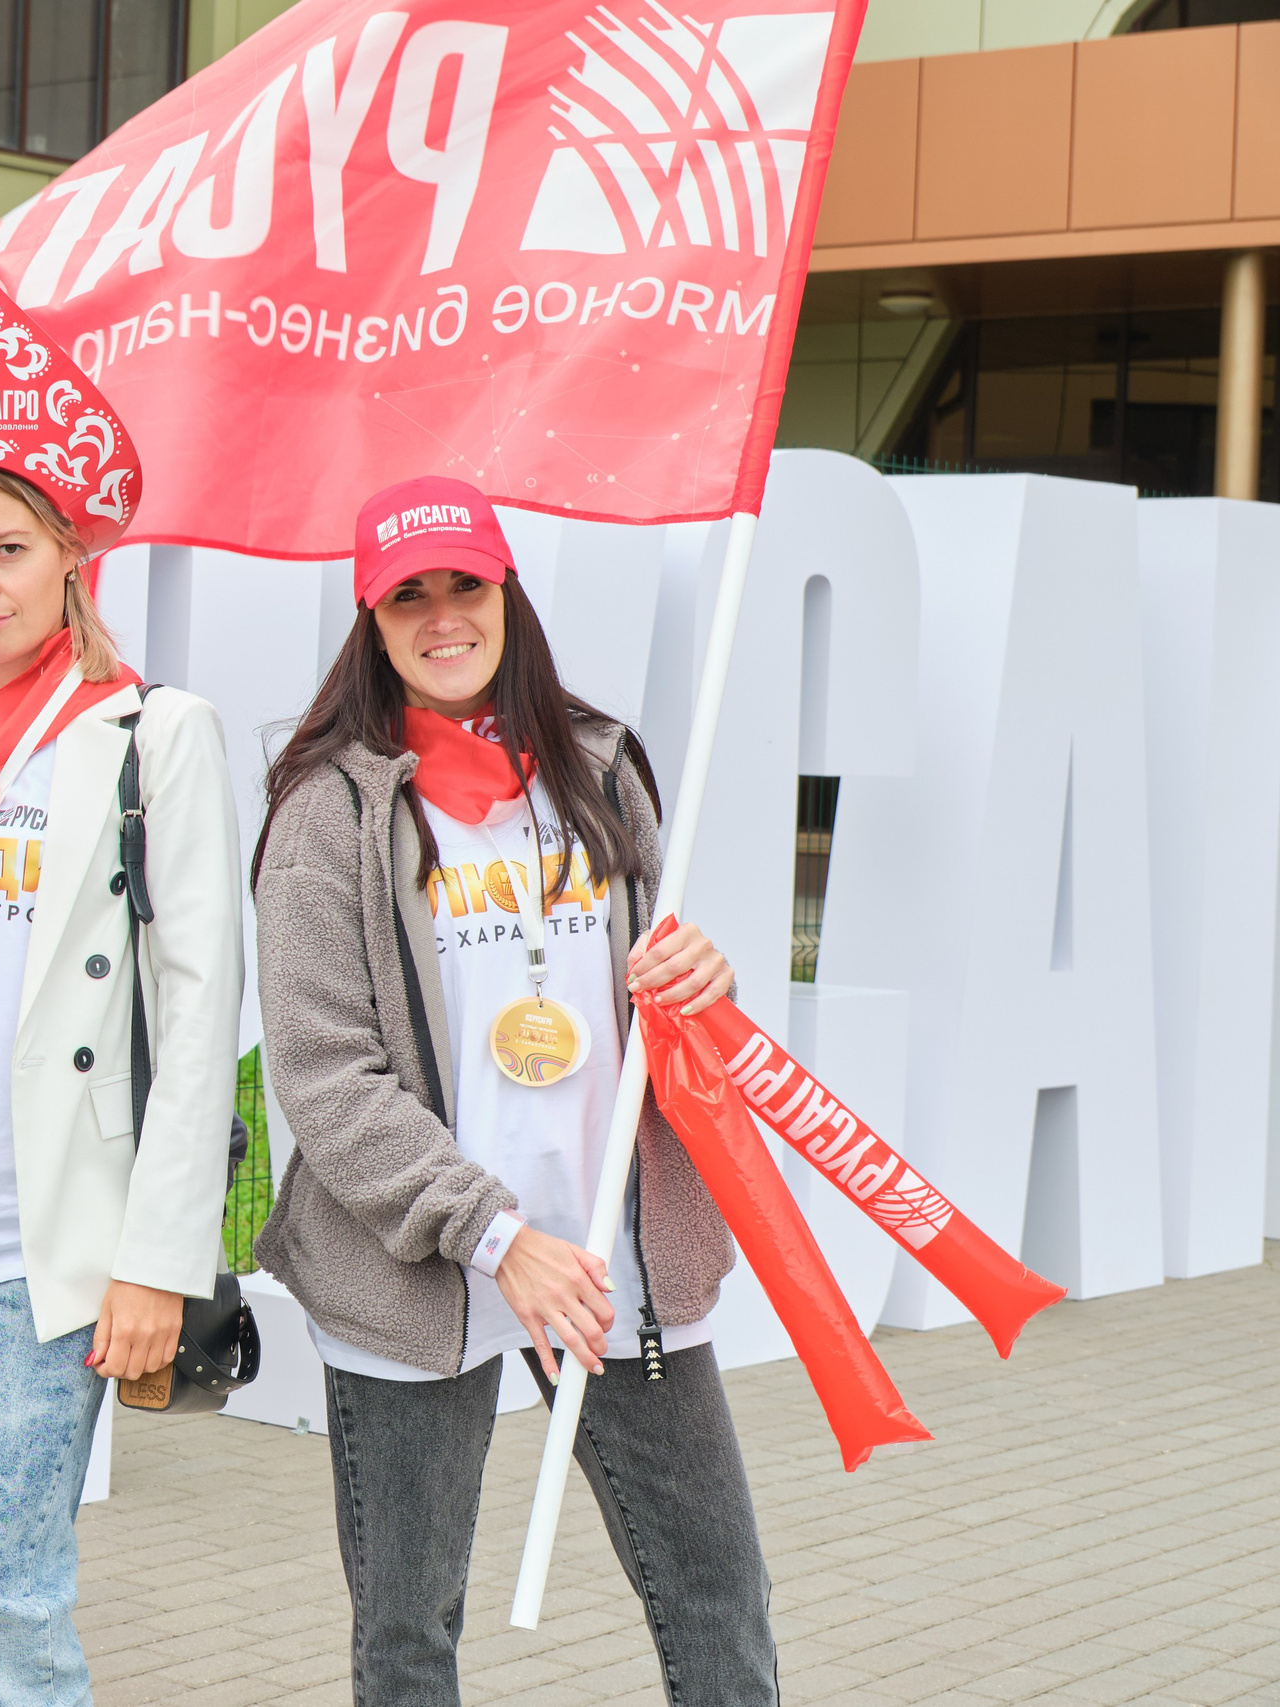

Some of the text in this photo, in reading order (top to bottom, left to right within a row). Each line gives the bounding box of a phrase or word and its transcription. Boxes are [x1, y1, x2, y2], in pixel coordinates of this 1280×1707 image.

[400, 505, 471, 531] РУСАГРО
[404, 528, 427, 538] бизнес
[726, 1032, 900, 1201] РУСАГРО
